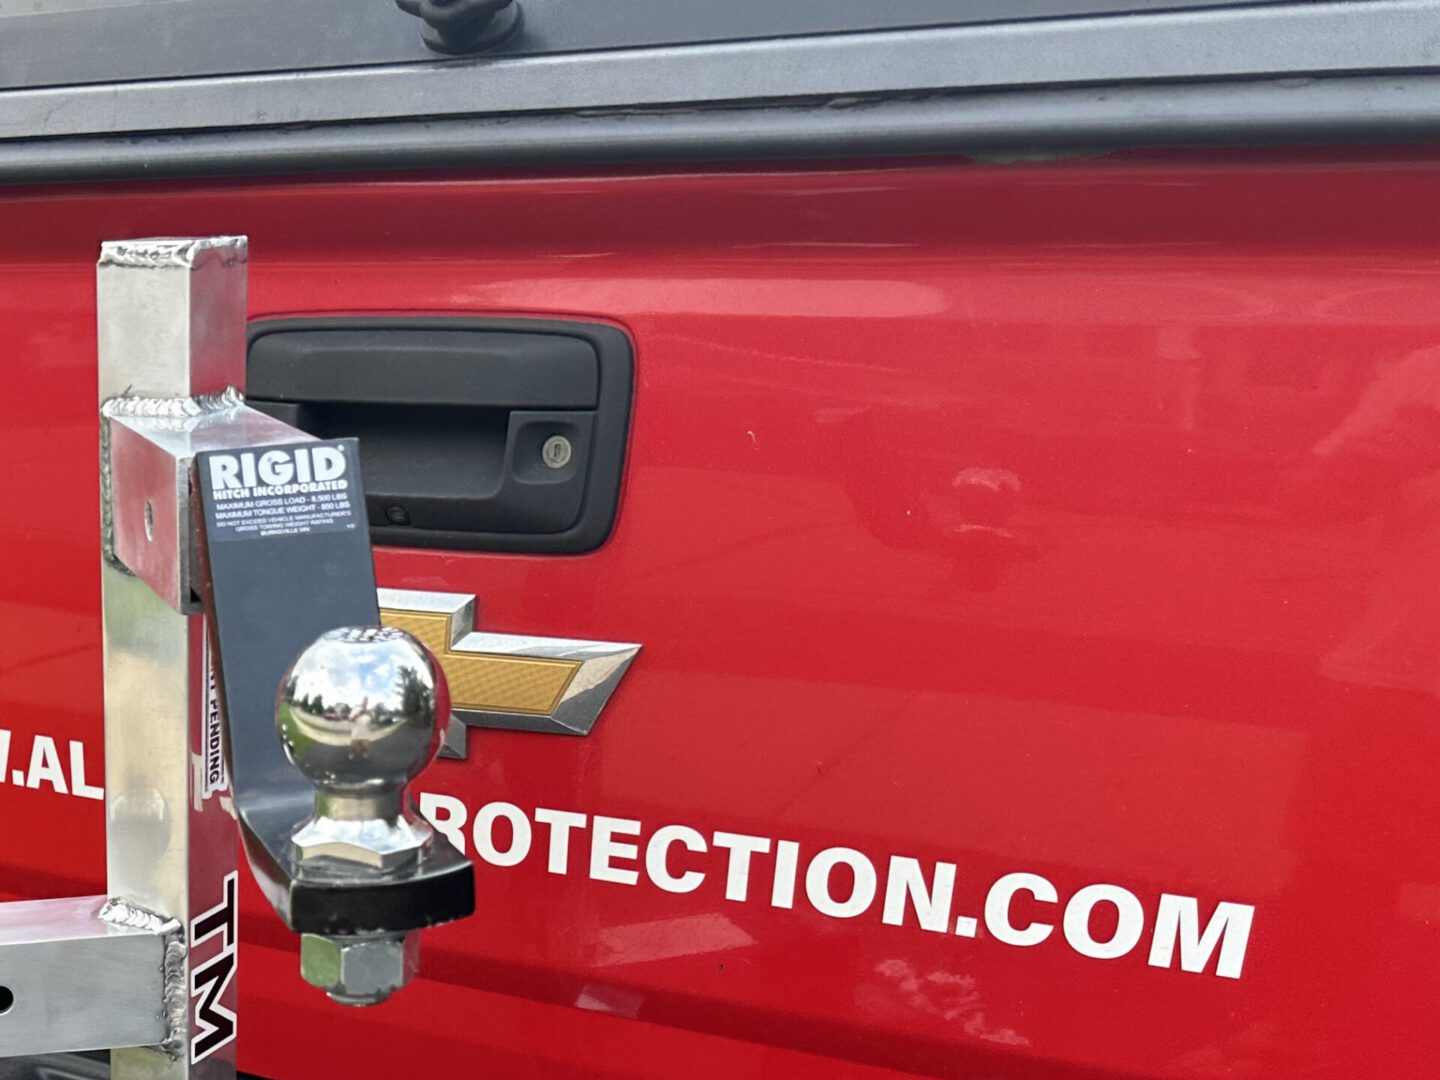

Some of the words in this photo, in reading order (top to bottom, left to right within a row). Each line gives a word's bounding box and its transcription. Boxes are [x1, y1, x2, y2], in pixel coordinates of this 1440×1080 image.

[209, 446, 346, 490] RIGID
[213, 486, 250, 500] HITCH
[253, 480, 348, 497] INCORPORATED
[215, 510, 253, 520] MAXIMUM
[254, 507, 285, 516] TONGUE
[286, 504, 316, 514] WEIGHT
[335, 501, 350, 509] LBS
[216, 500, 254, 510] MAXIMUM
[255, 498, 283, 508] GROSS
[284, 496, 305, 505] LOAD
[332, 493, 347, 501] LBS
